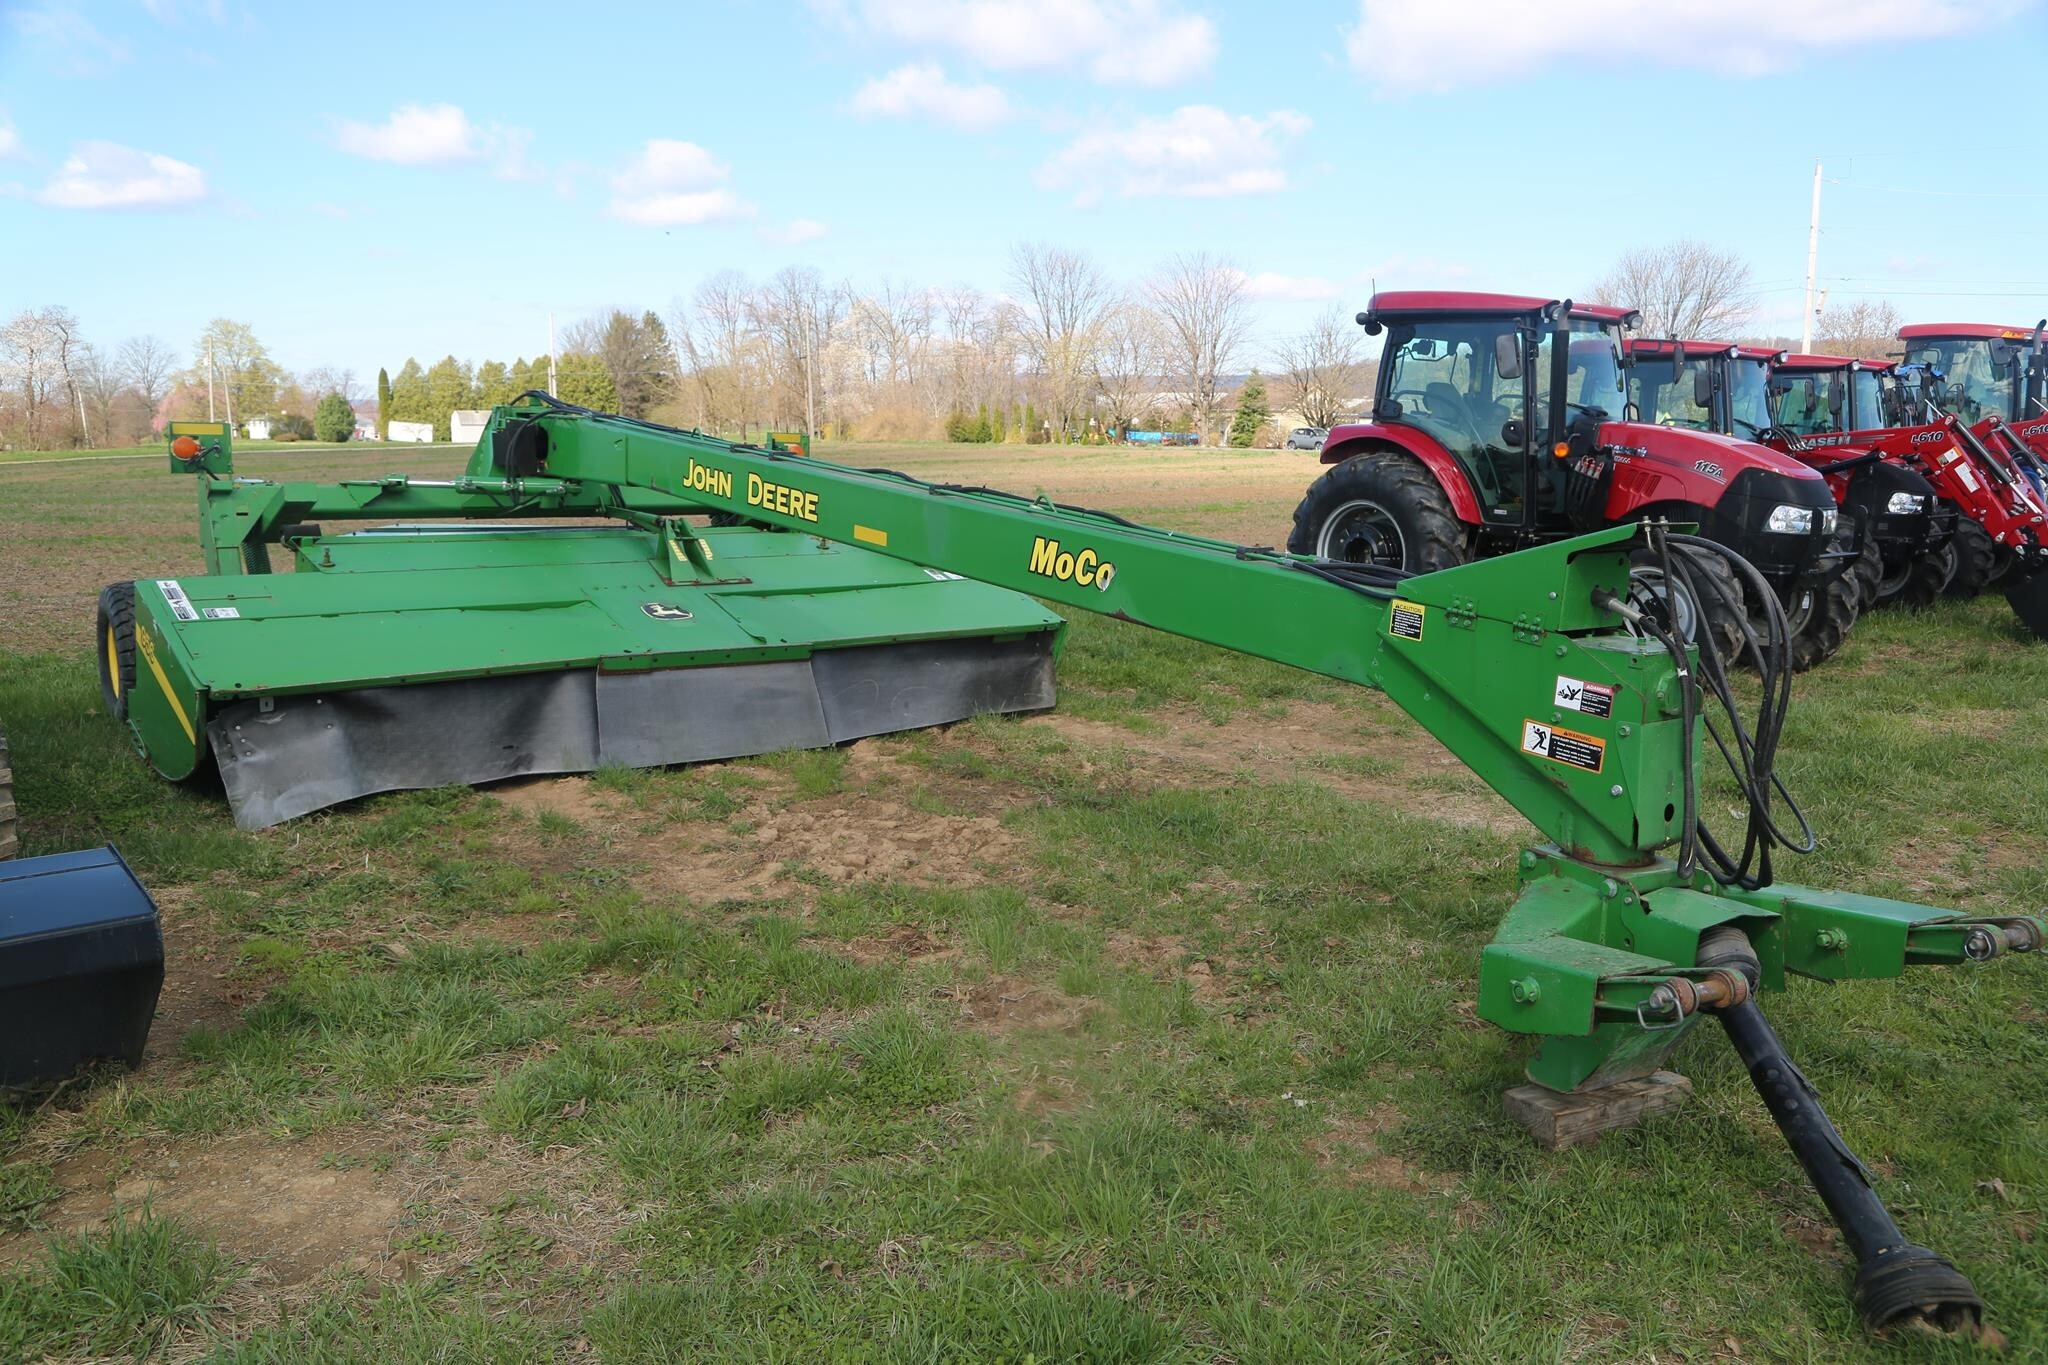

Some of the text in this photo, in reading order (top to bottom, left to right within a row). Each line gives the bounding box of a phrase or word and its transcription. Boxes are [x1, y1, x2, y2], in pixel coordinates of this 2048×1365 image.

[1910, 430, 1944, 444] L610
[1694, 459, 1724, 478] 115A
[682, 457, 820, 524] JOHN DEERE
[1028, 535, 1117, 592] MoCo
[1399, 604, 1422, 614] CAUTION
[1568, 731, 1592, 743] WARNING
